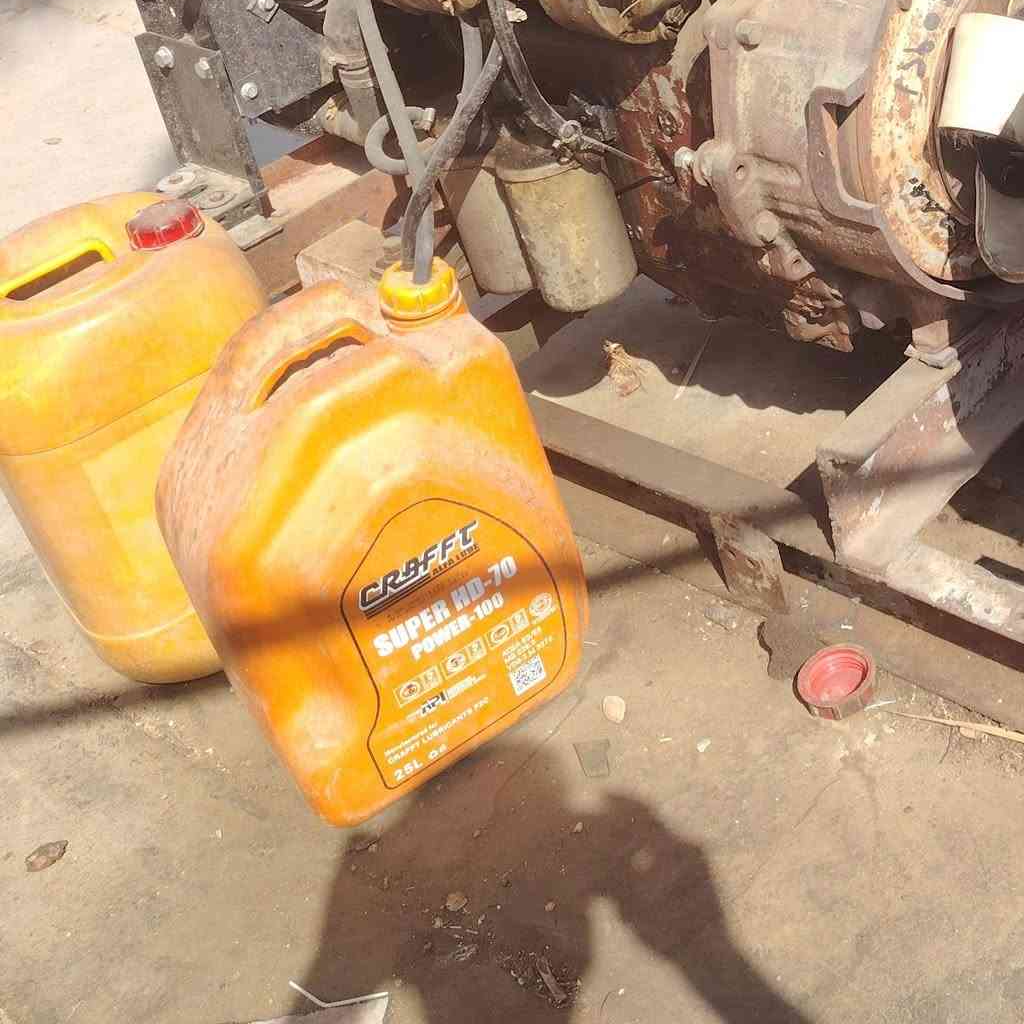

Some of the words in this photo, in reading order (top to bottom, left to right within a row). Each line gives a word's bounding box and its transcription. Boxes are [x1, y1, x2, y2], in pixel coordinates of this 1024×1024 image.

[359, 519, 479, 610] CRAFFT
[373, 599, 451, 657] SUPER
[450, 555, 518, 612] HD-70
[410, 591, 505, 661] POWER-100
